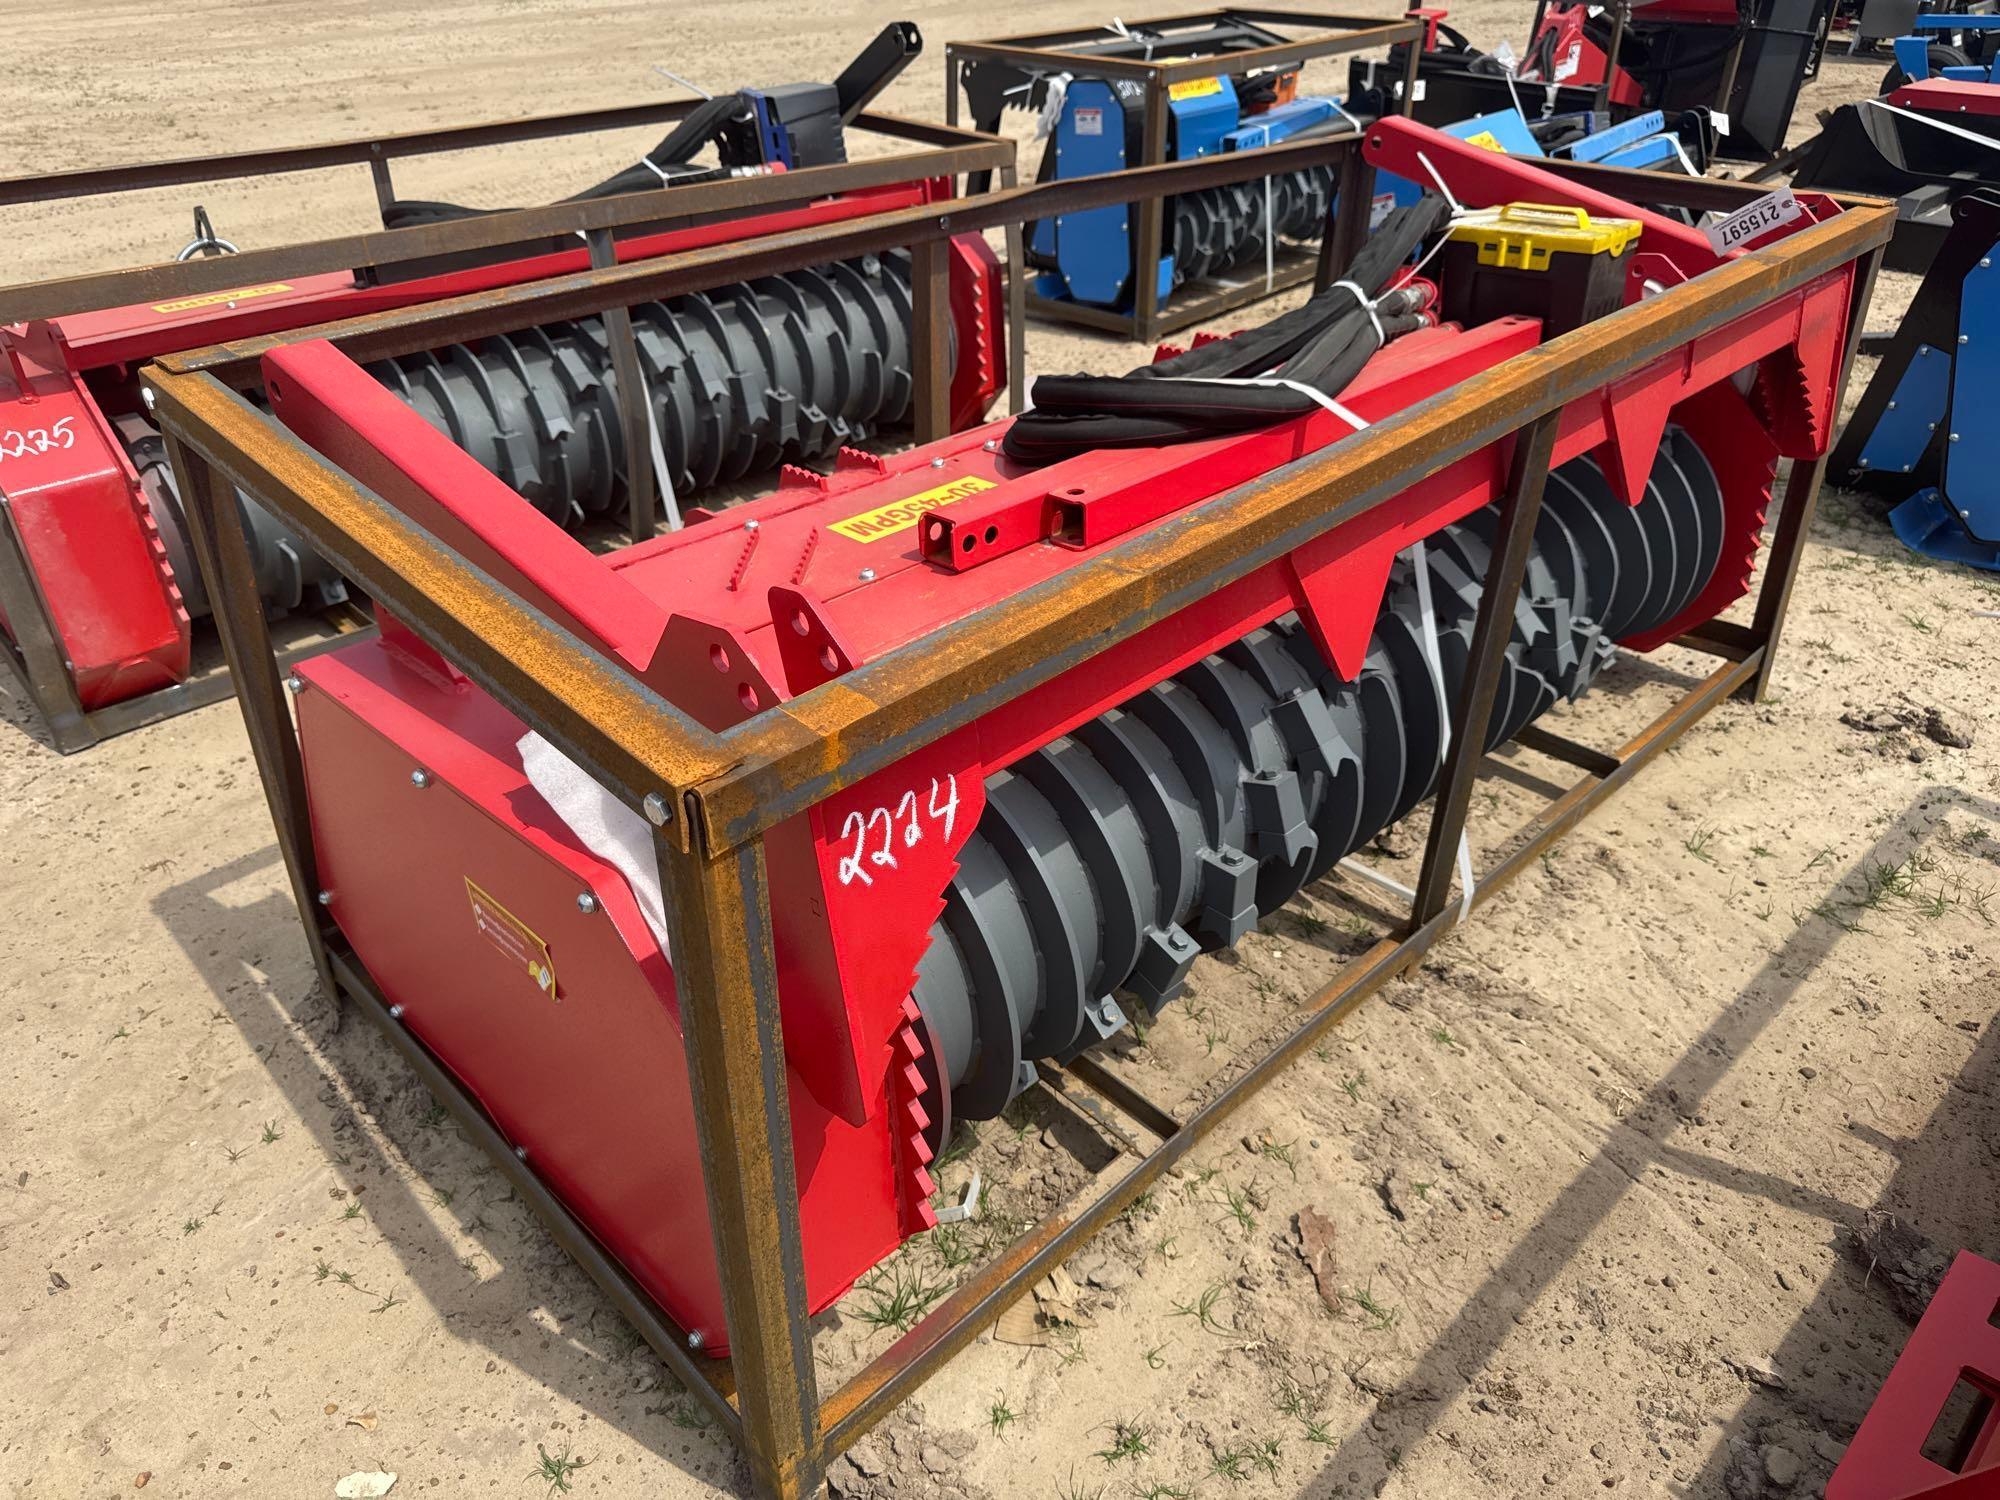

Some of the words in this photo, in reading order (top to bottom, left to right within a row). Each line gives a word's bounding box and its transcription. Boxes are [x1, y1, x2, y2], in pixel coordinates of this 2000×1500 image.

[1722, 205, 1780, 246] 215597
[0, 416, 75, 462] 225
[838, 773, 960, 886] 2224
